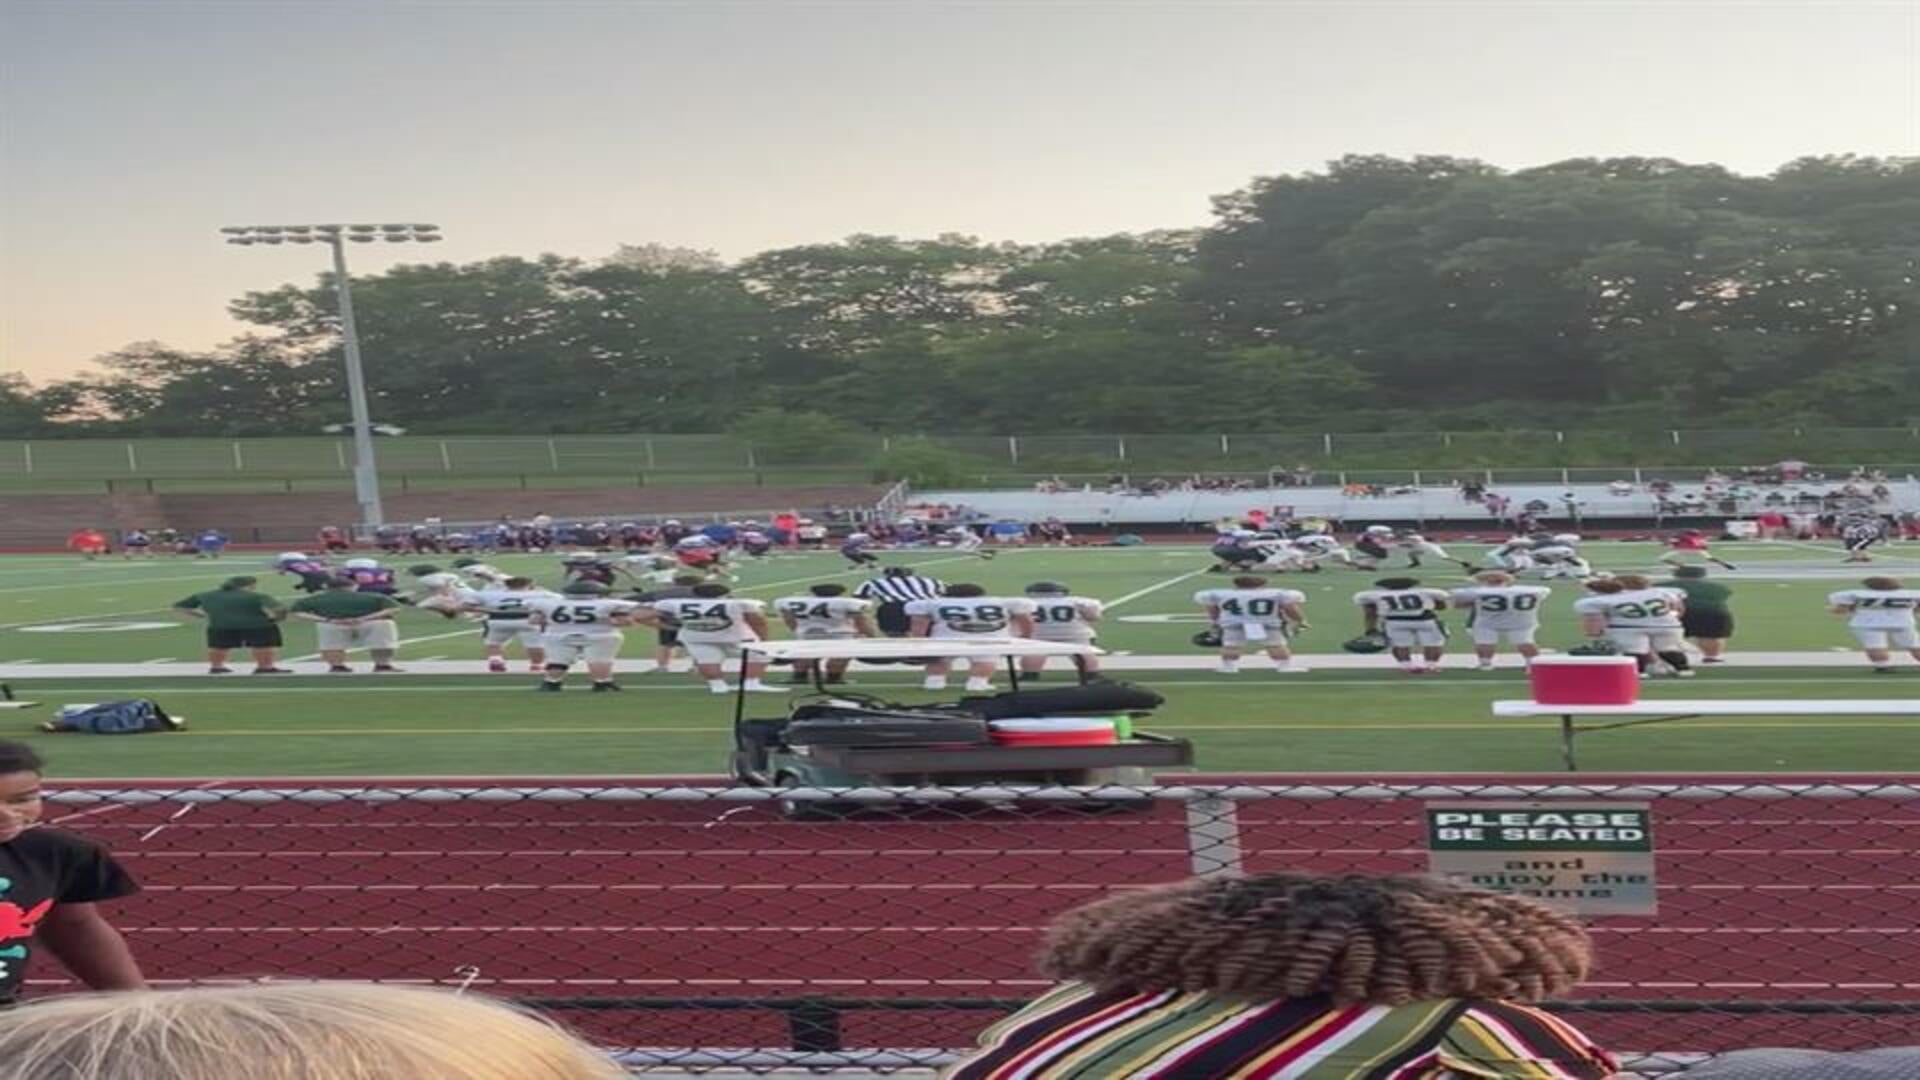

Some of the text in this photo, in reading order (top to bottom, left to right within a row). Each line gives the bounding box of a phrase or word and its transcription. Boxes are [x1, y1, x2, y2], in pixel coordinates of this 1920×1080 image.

[789, 601, 830, 619] 24
[1222, 599, 1274, 616] 40
[1380, 594, 1423, 611] 10
[1480, 594, 1538, 612] 30
[1613, 599, 1668, 619] 32
[552, 606, 596, 623] 65
[680, 604, 728, 621] 54
[938, 606, 1005, 621] 68
[1435, 813, 1642, 827] PLEASE
[1438, 828, 1643, 841] BE SEATED
[1504, 858, 1584, 870] and
[1453, 873, 1647, 890] njoy the
